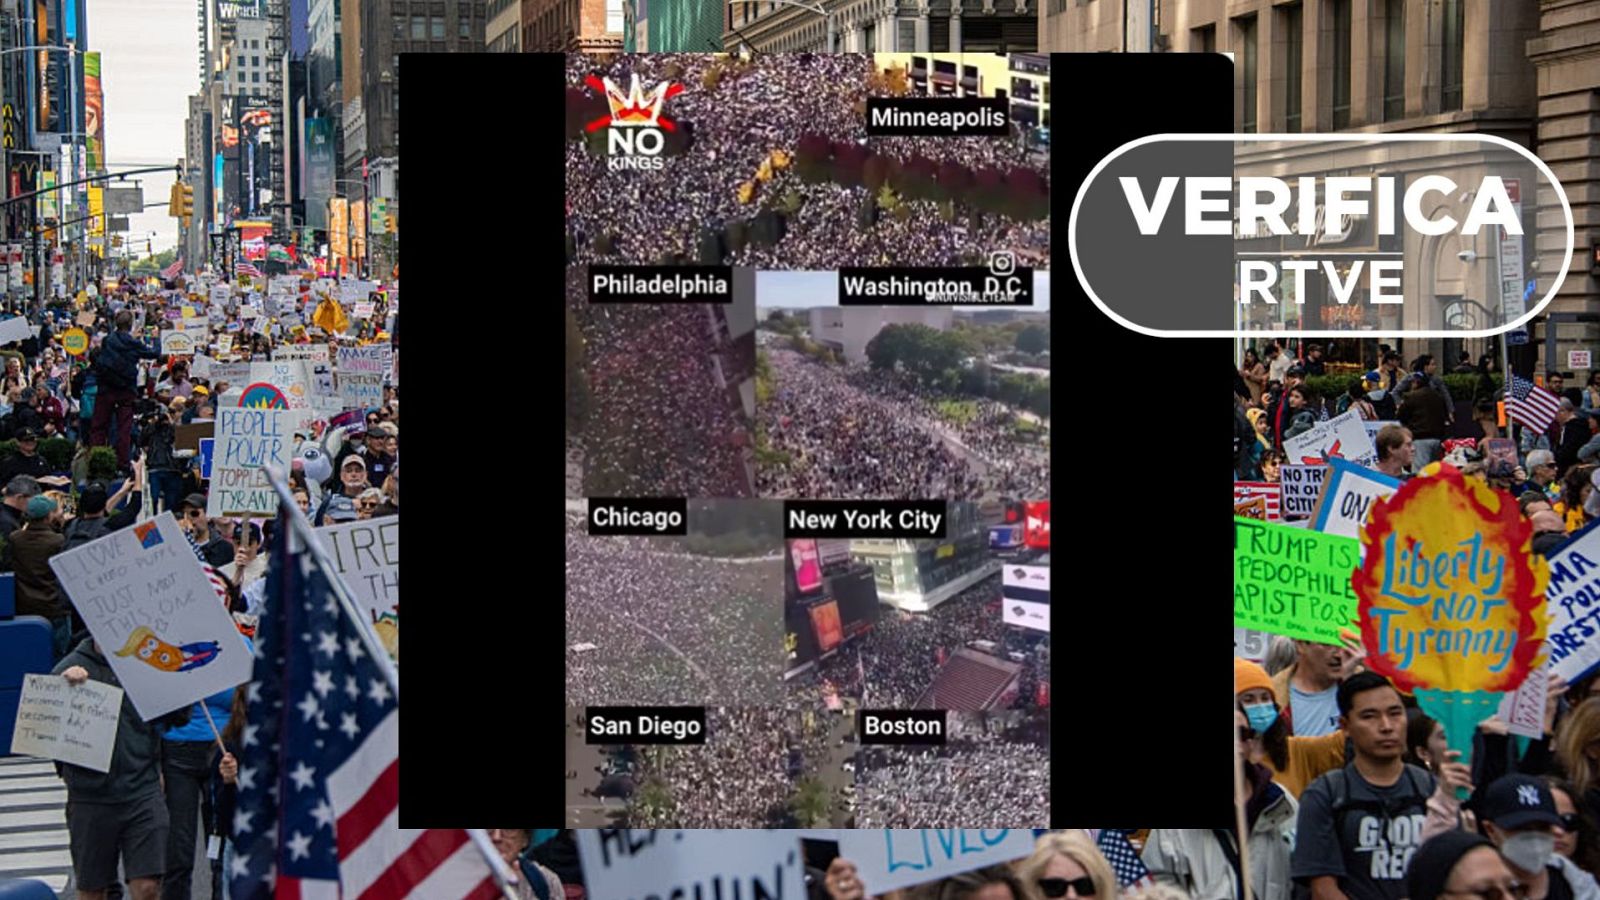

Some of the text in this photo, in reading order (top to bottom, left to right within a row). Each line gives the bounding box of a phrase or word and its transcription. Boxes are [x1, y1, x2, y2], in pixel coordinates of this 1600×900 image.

[222, 410, 283, 437] PEOPLE
[225, 438, 284, 465] POWER
[218, 467, 271, 488] TOPPLE
[1283, 468, 1302, 482] NO
[218, 490, 280, 510] TYRANT
[1285, 485, 1299, 495] IN
[1341, 490, 1370, 524] ON
[1328, 544, 1352, 569] IS
[1380, 531, 1506, 606] Liberty
[1238, 555, 1358, 601] PEDOPHILE
[1432, 592, 1509, 621] NOT
[1368, 606, 1519, 673] Tyranny
